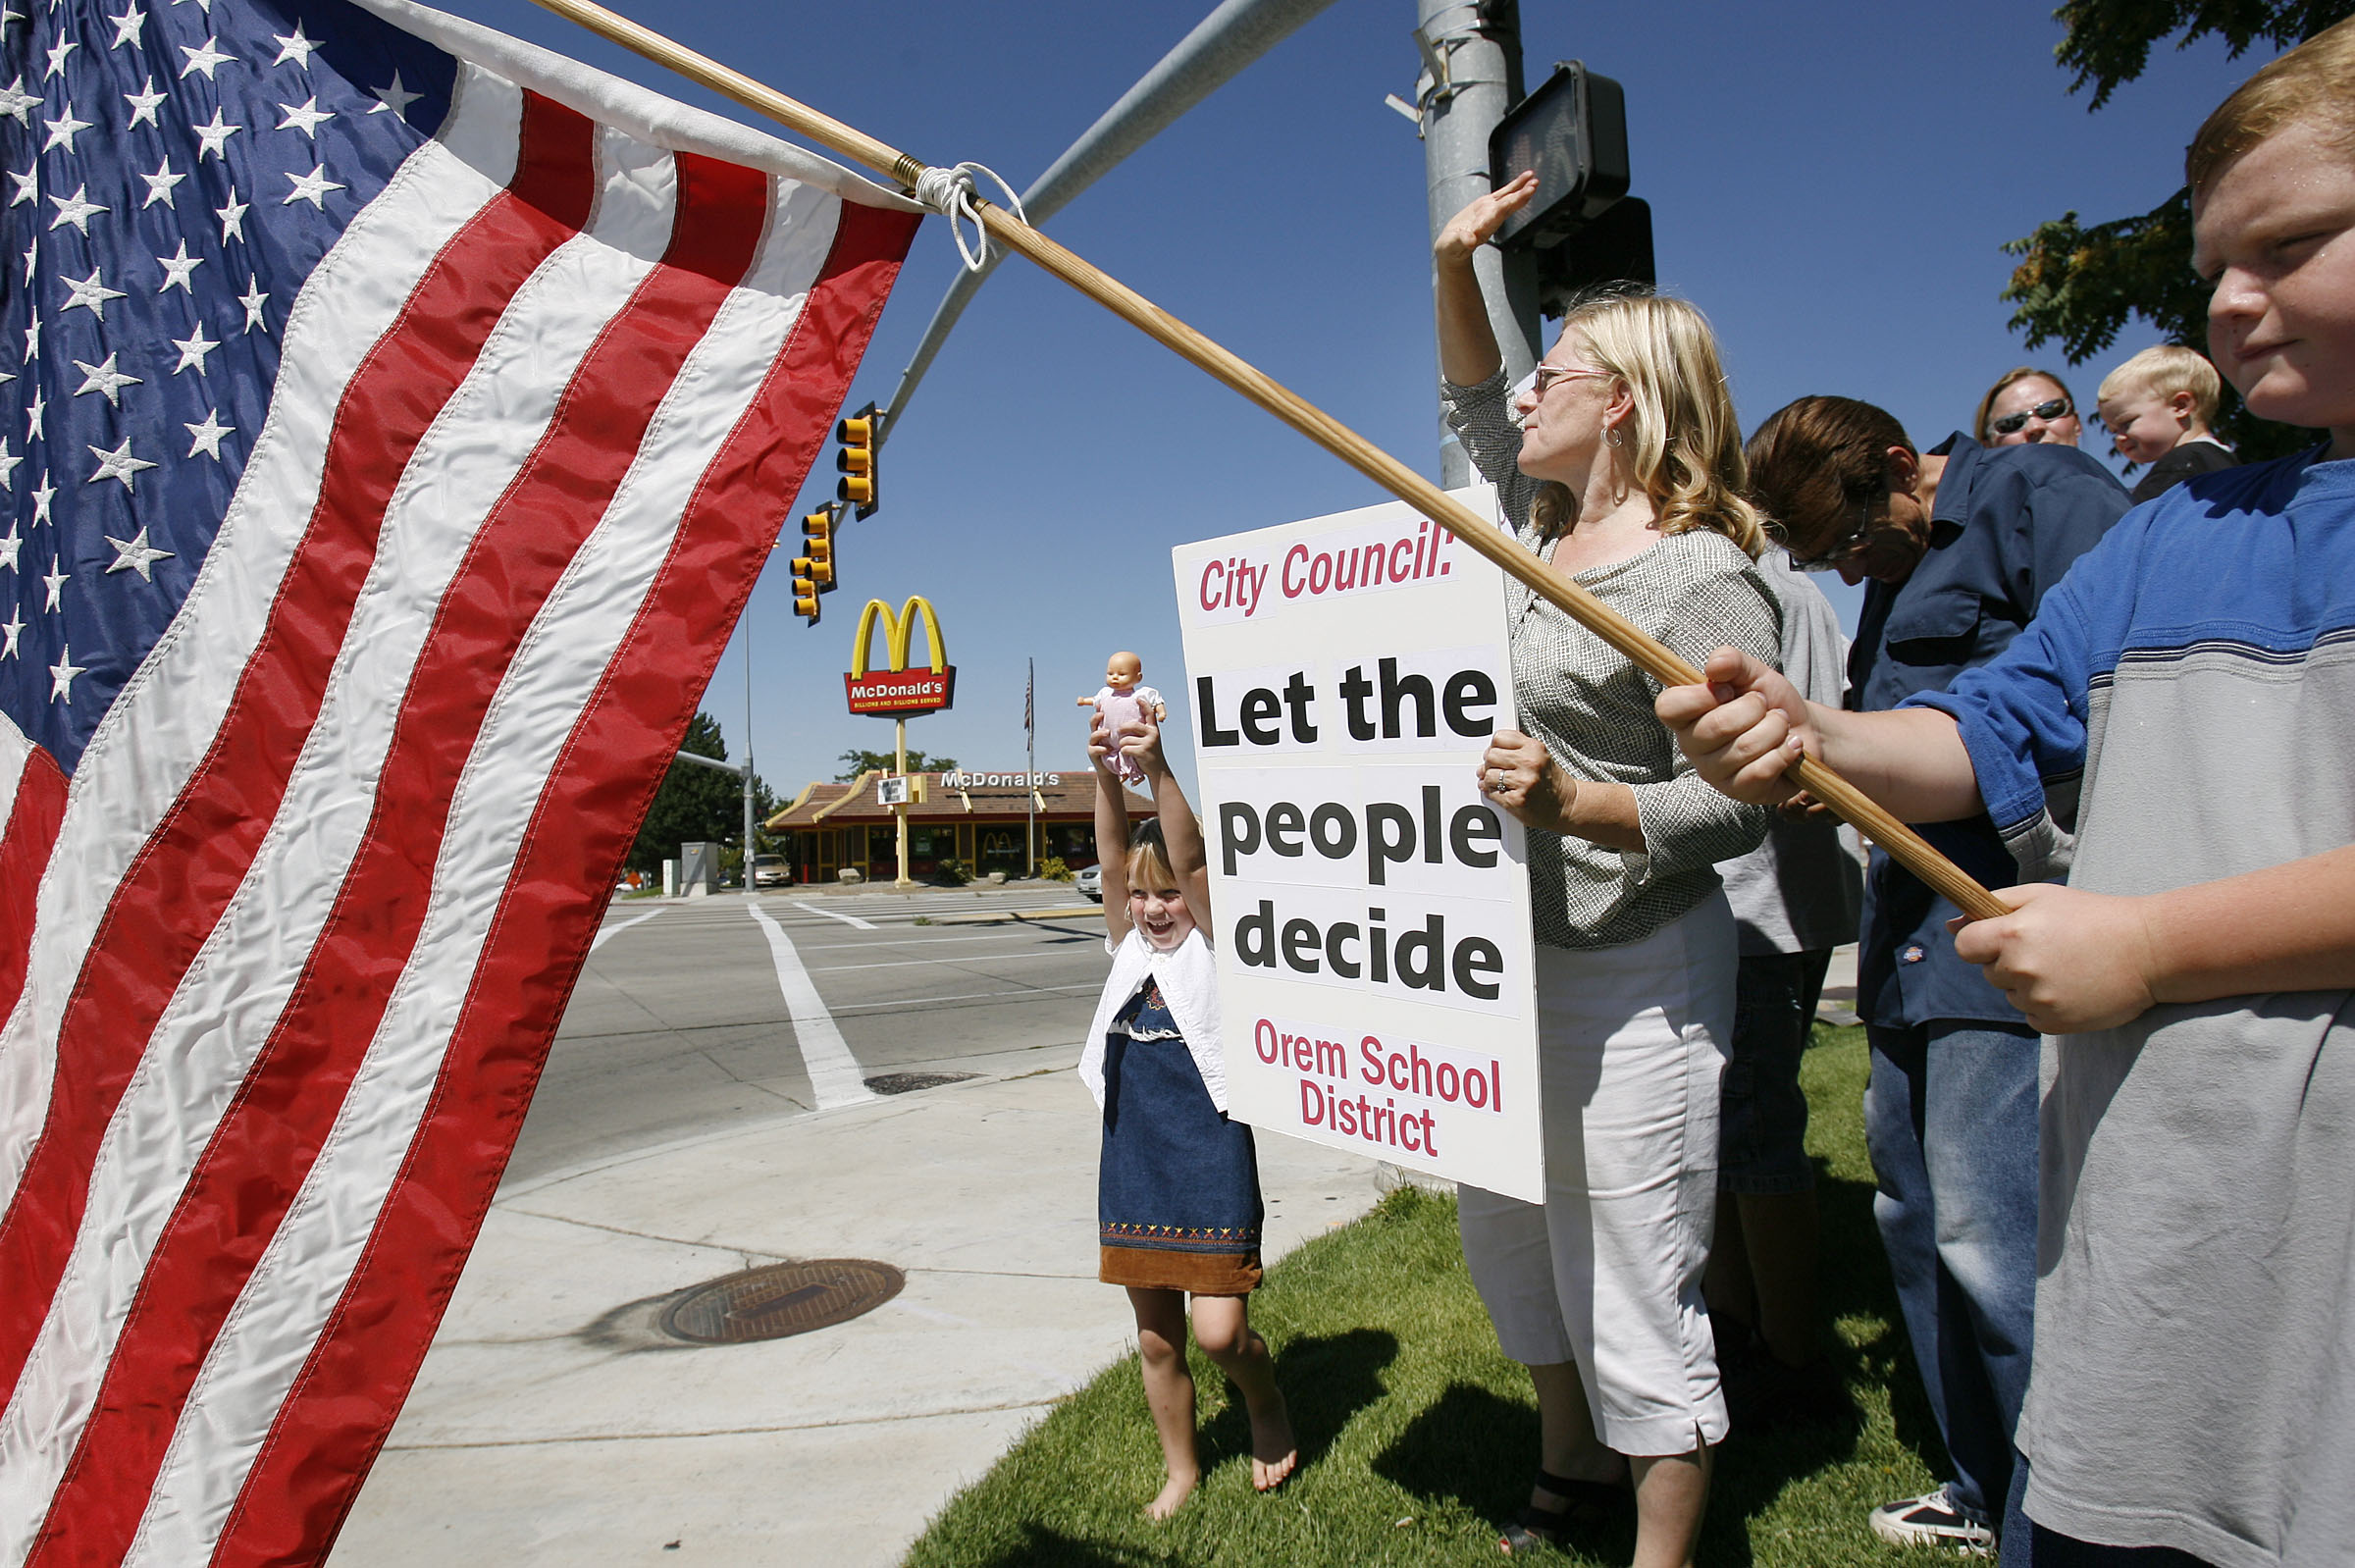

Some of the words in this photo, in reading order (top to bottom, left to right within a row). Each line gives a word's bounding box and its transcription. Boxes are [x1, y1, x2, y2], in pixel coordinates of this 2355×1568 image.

[1200, 557, 1269, 617] City
[1282, 521, 1454, 599] Council:
[851, 682, 943, 700] McDonald's
[1196, 671, 1318, 747] Let
[1339, 657, 1497, 741] the
[941, 771, 1060, 787] McDonald's
[1219, 785, 1501, 885] people
[1234, 900, 1503, 1000] decide
[1255, 1019, 1347, 1079] Orem
[1361, 1035, 1501, 1113] School
[1301, 1079, 1438, 1157] District
